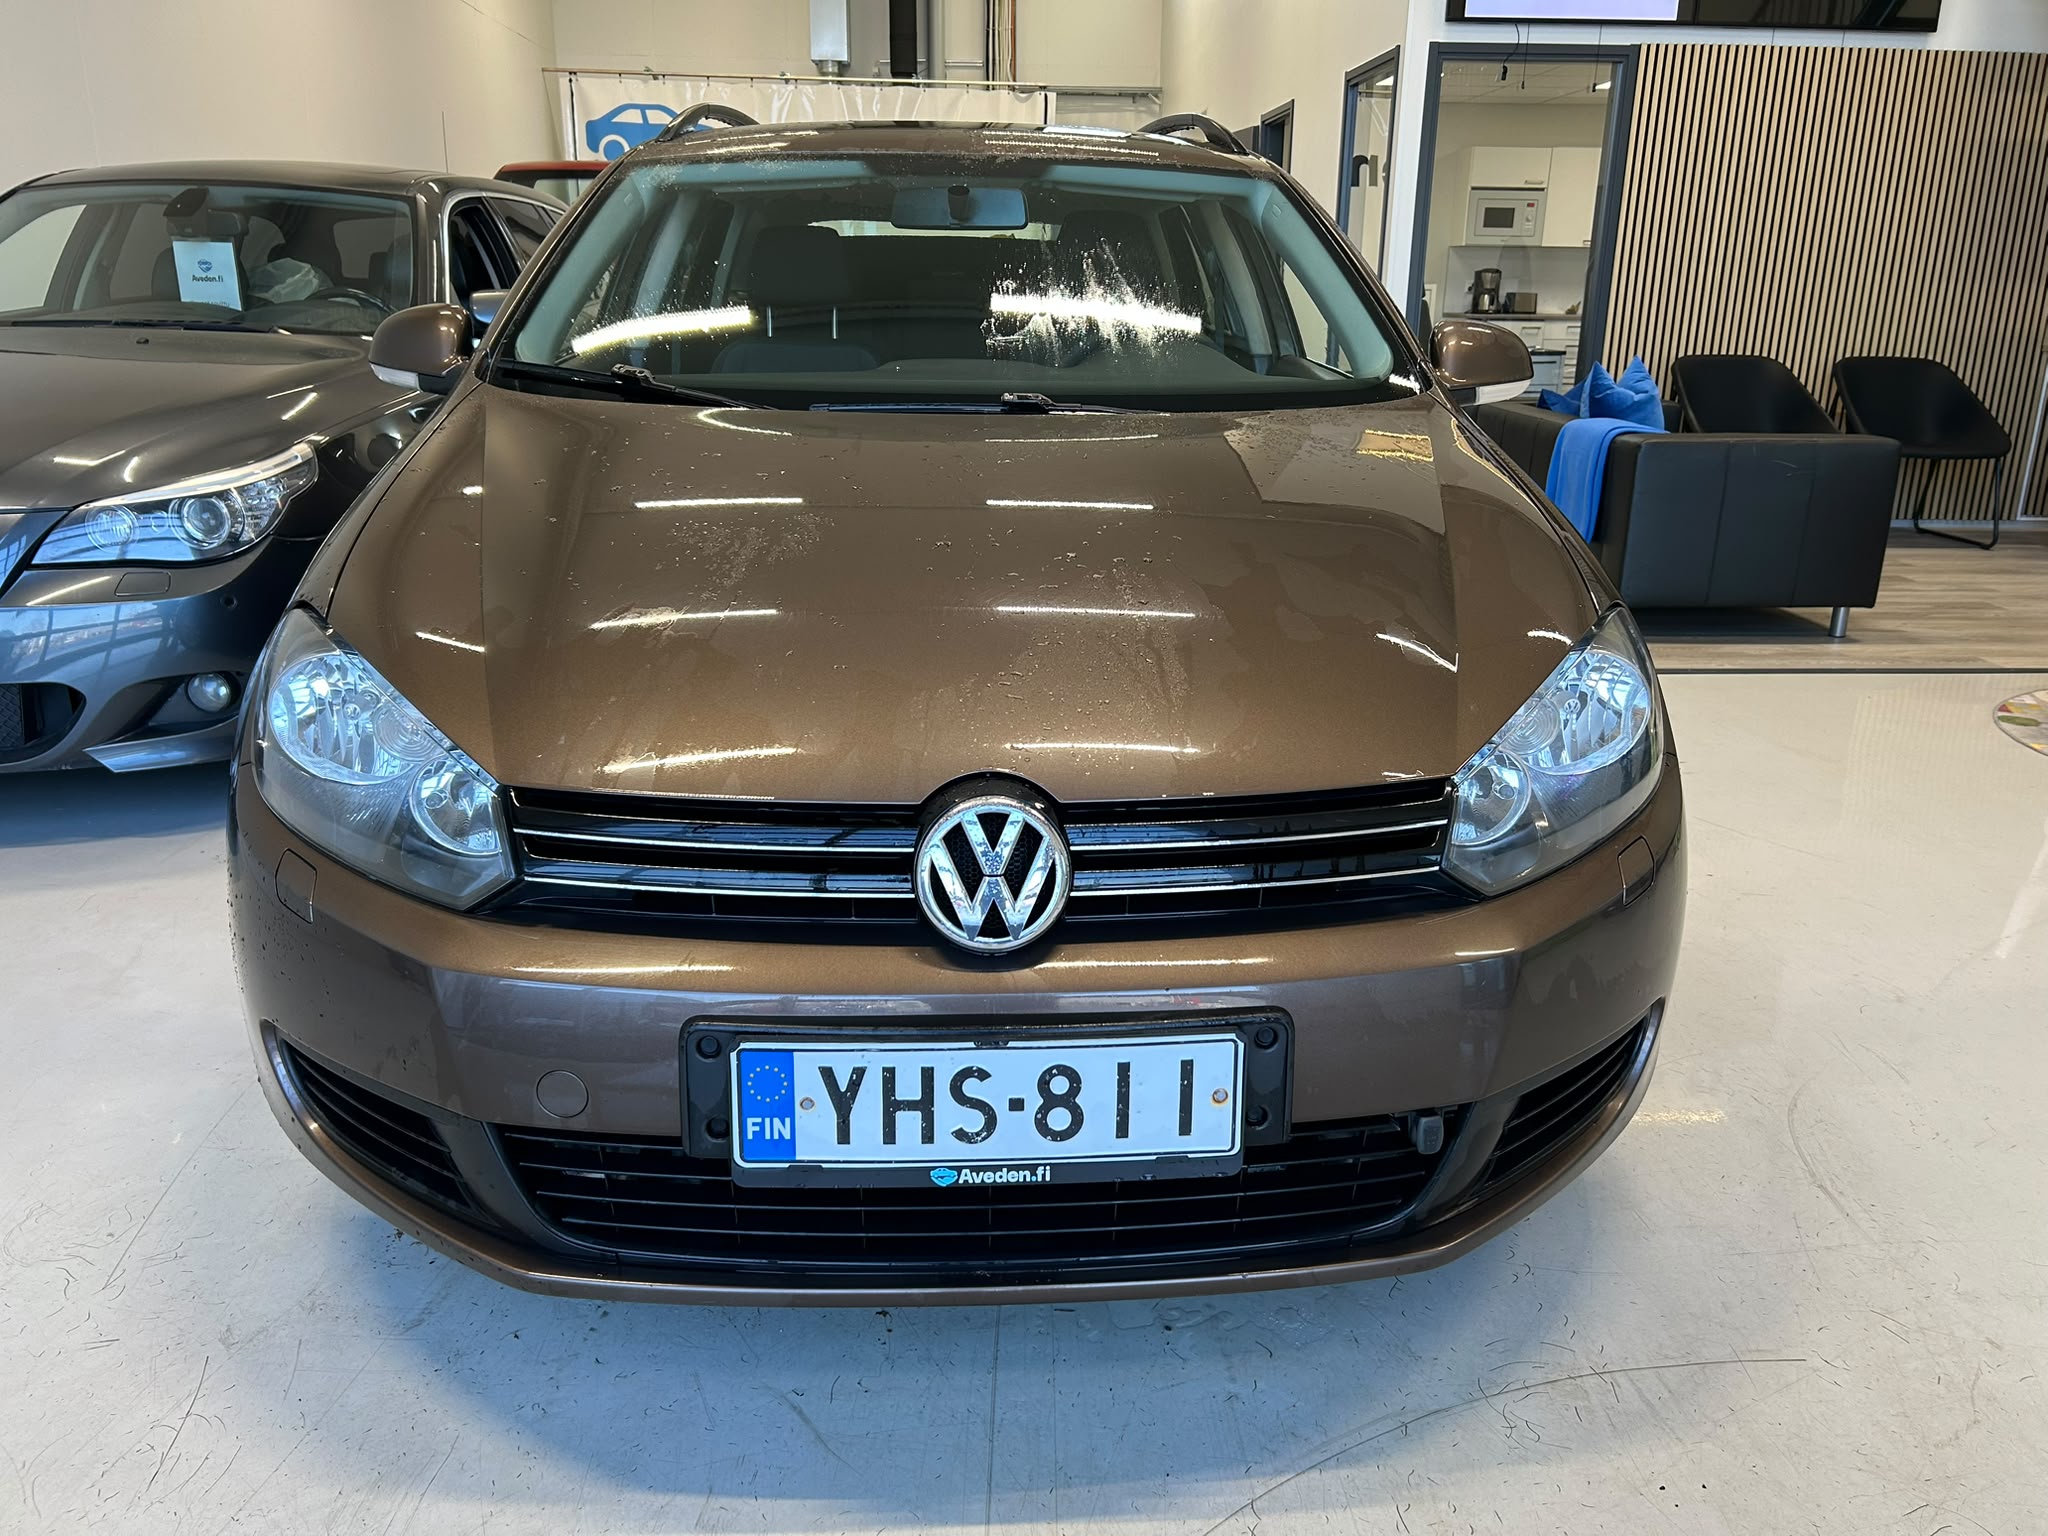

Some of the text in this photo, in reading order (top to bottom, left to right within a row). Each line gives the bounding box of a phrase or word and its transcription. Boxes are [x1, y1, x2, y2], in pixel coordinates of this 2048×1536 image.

[192, 274, 224, 283] Aveden.fi
[927, 808, 1056, 942] VW
[817, 1058, 1195, 1146] YHS-811
[746, 1117, 791, 1140] FIN
[958, 1165, 1051, 1184] Aveden.fi
